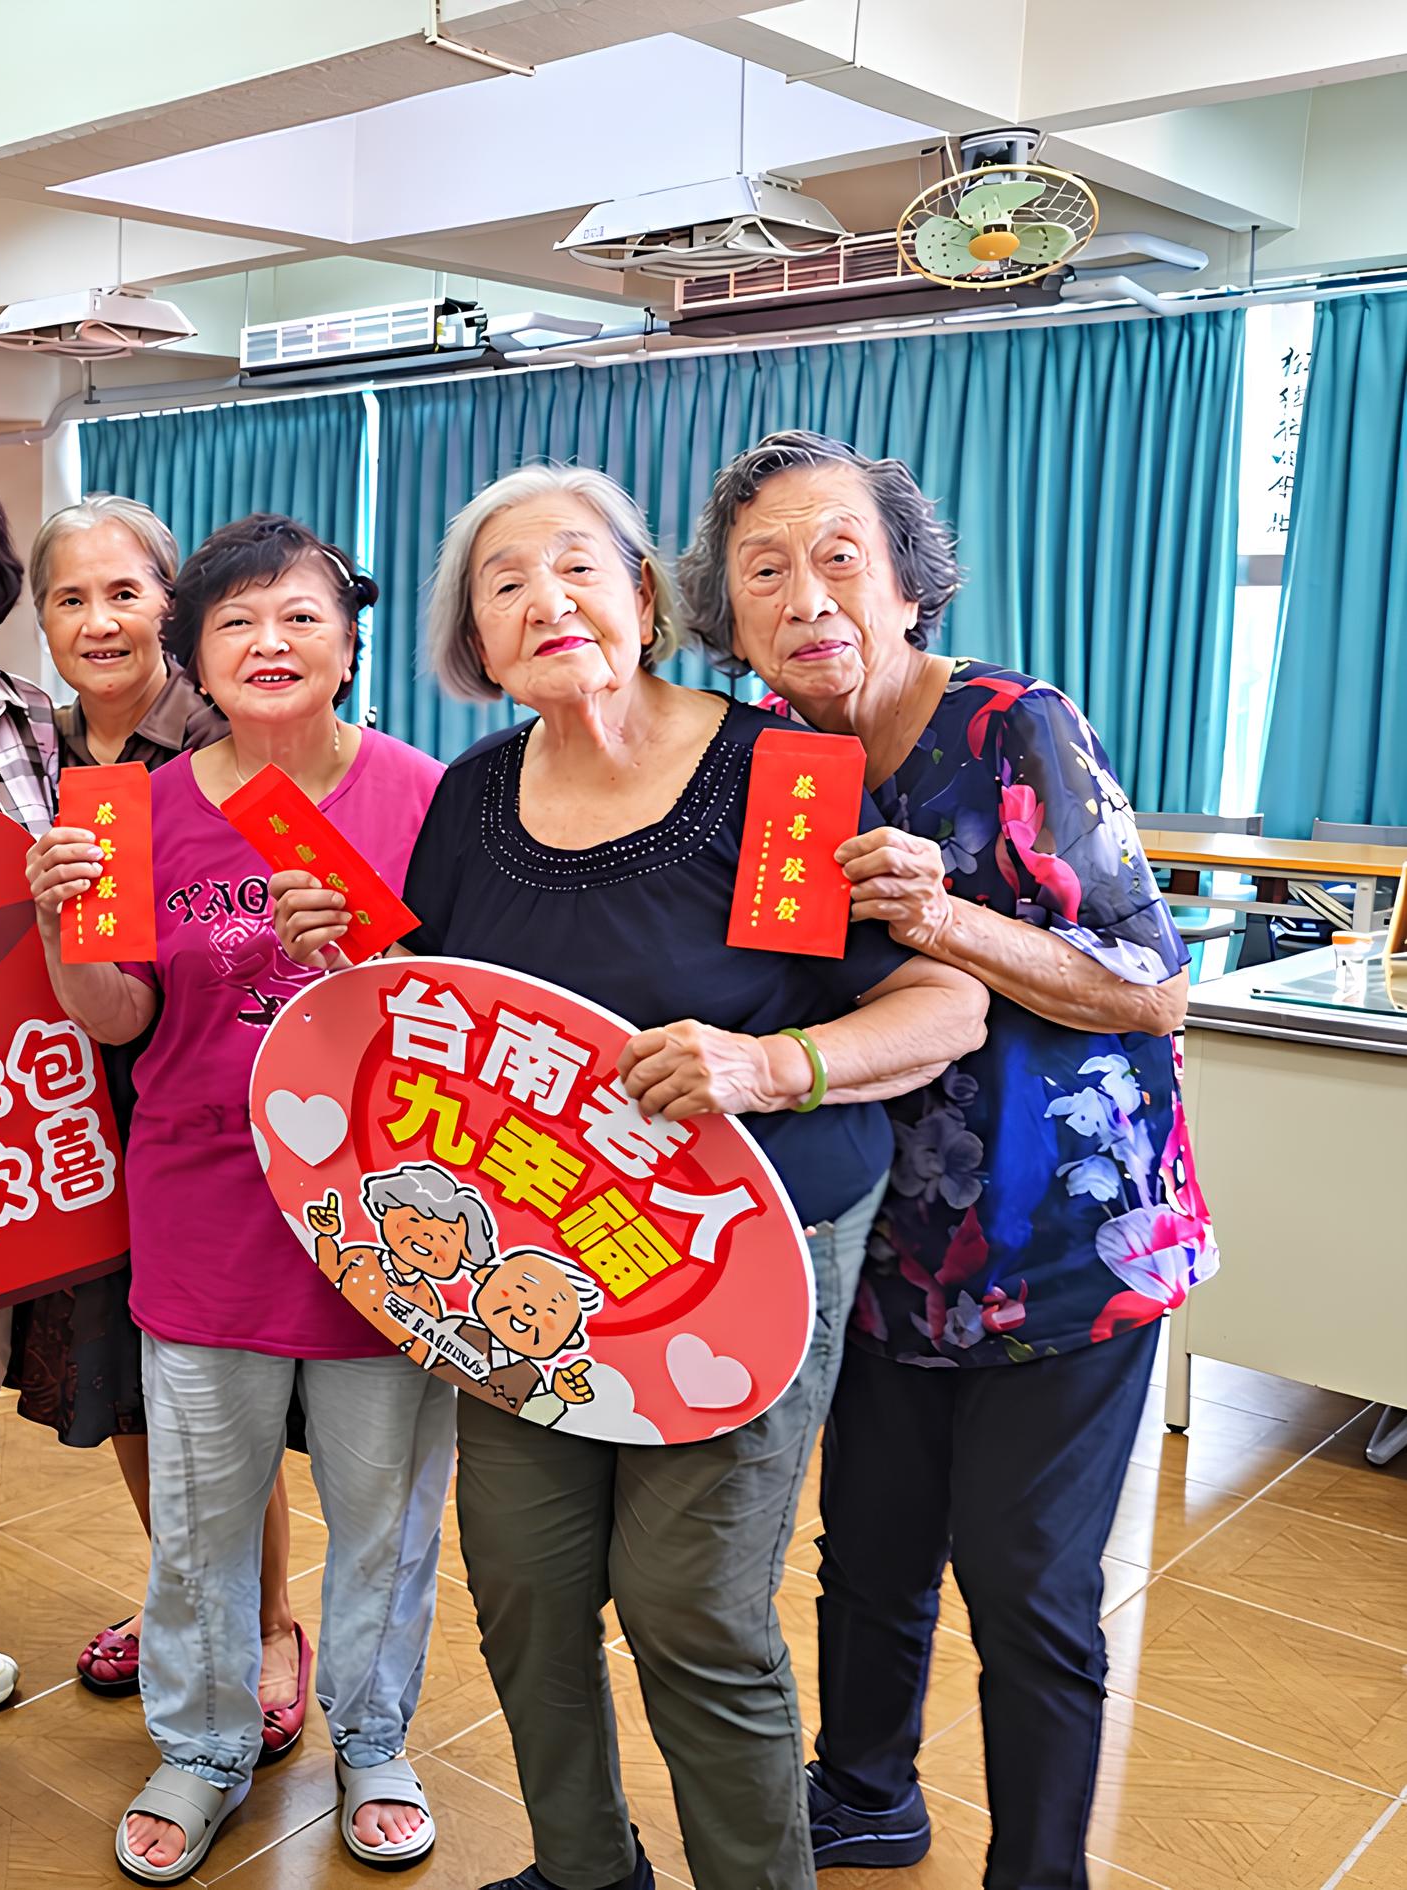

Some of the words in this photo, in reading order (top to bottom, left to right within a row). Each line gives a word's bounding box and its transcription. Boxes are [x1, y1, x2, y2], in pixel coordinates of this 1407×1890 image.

[386, 977, 758, 1264] 台南老人
[387, 1072, 683, 1300] 九幸福
